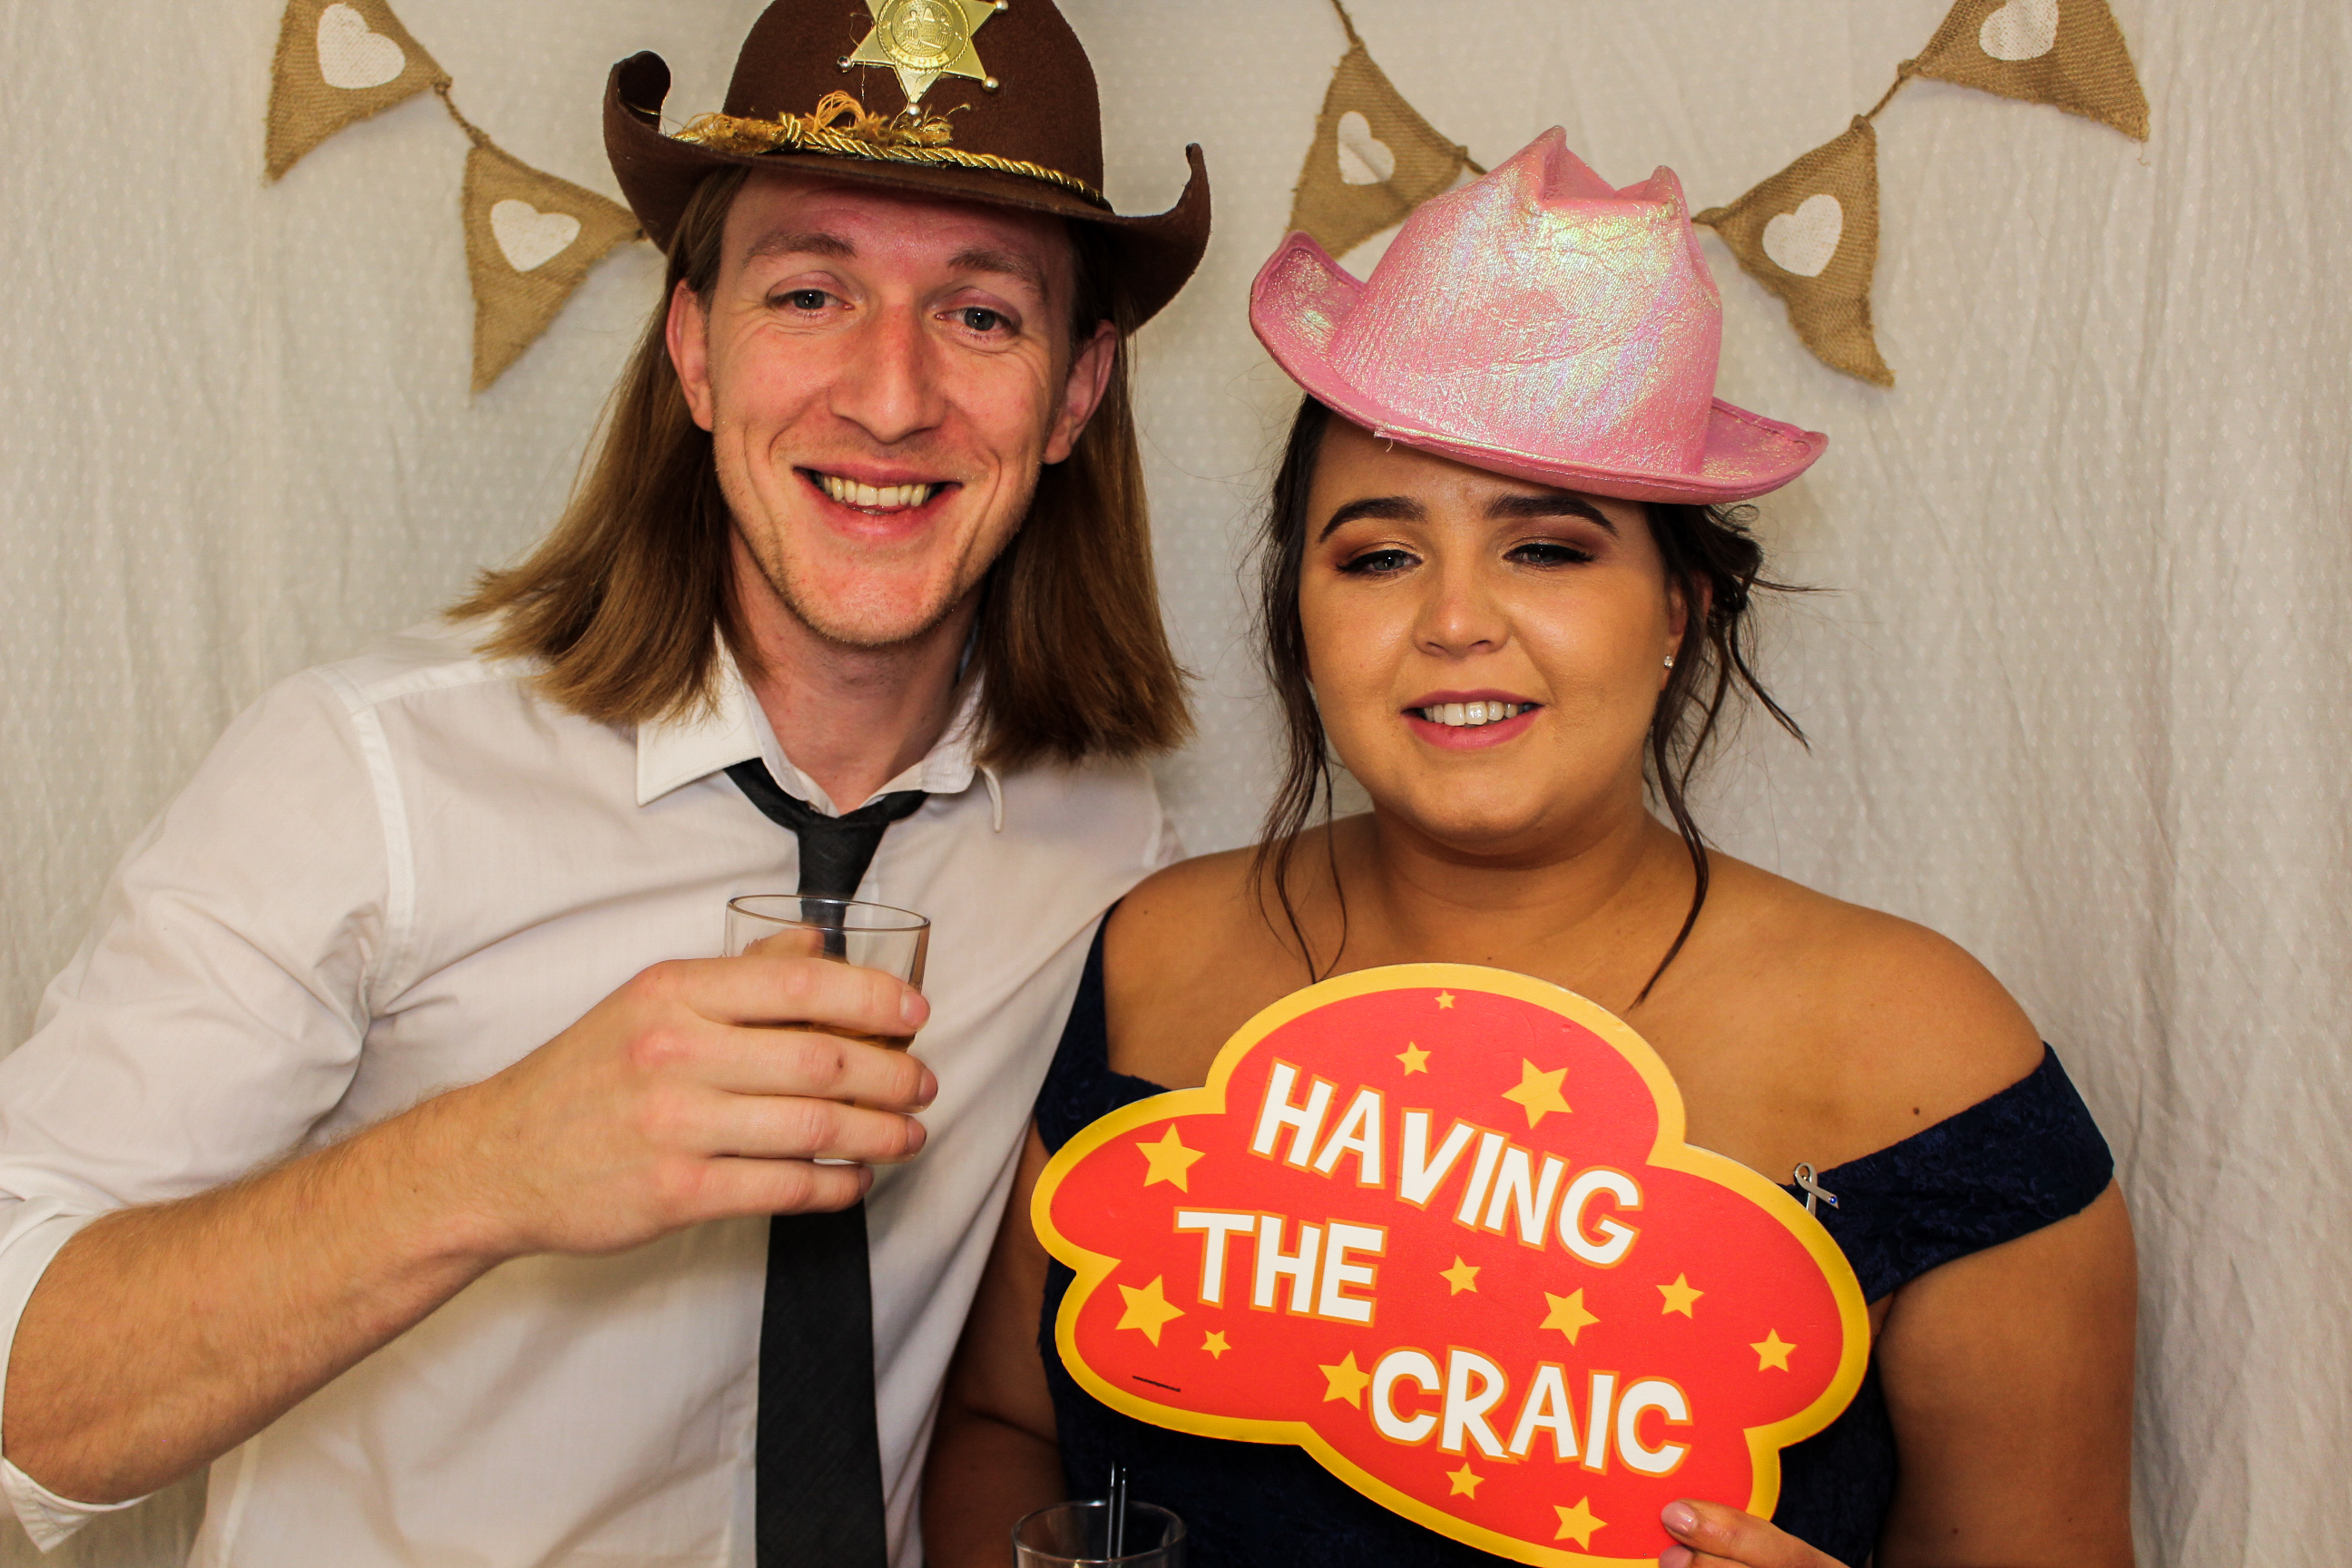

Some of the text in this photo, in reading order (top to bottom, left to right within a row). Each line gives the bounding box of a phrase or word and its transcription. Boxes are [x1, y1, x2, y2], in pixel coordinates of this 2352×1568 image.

[1251, 1061, 1640, 1266] HAVING
[1176, 1209, 1385, 1324] THE
[1371, 1348, 1689, 1475] CRAIC
